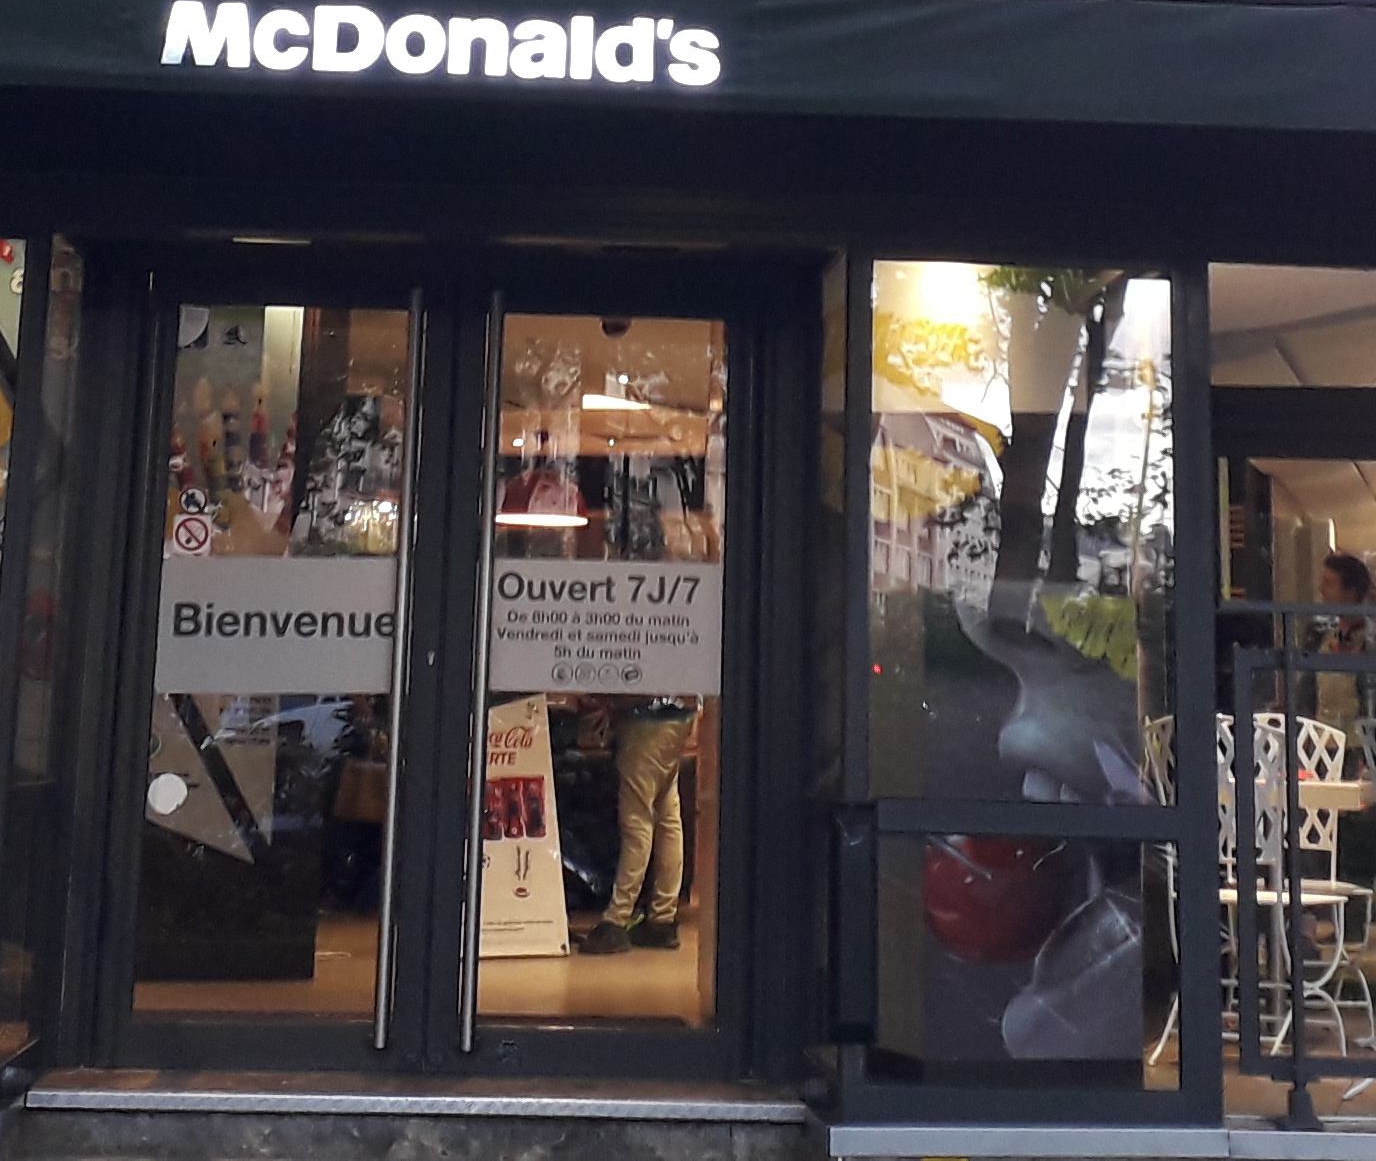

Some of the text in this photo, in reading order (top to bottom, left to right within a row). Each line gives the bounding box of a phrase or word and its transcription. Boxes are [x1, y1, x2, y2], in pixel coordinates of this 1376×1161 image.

[160, 0, 721, 86] McDonald's
[497, 572, 702, 605] Ouvert 7J/7
[174, 602, 395, 638] Bienvenue
[507, 610, 527, 624] De
[625, 612, 644, 626] du
[648, 613, 690, 628] matin
[496, 627, 563, 640] Vendredi
[568, 628, 582, 641] et
[587, 629, 641, 642] samedi
[576, 646, 595, 659] du
[599, 647, 642, 660] matin
